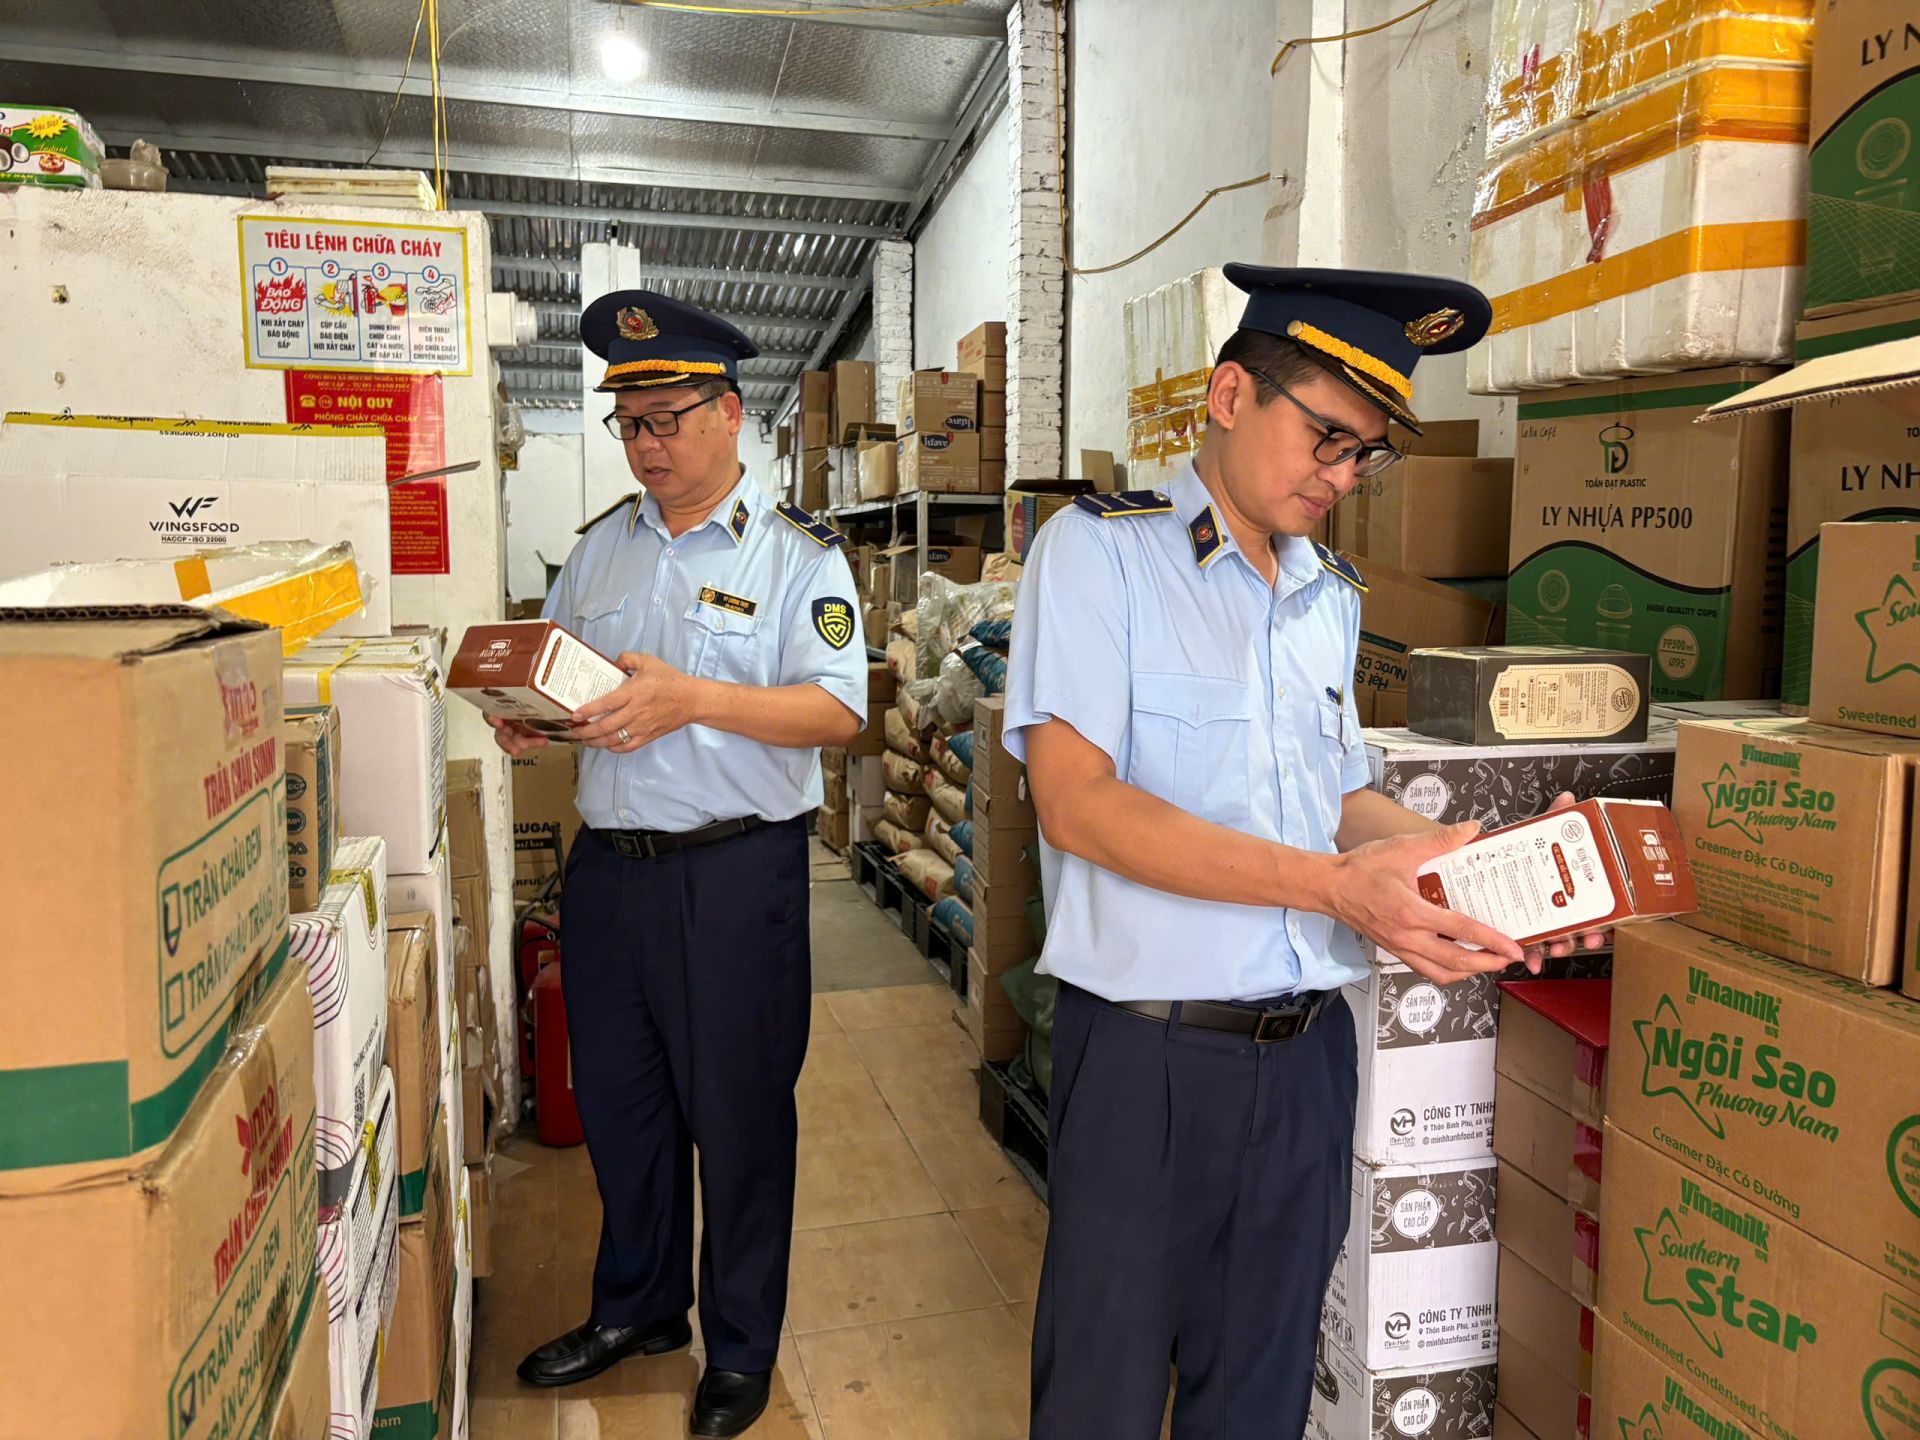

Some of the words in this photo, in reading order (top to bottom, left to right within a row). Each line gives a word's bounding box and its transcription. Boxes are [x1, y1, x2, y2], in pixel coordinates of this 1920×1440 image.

[1861, 29, 1892, 66] LY
[265, 229, 300, 249] TIÊU
[305, 233, 348, 256] LỆNH
[353, 233, 396, 255] CHỮA
[401, 238, 443, 258] CHÁY
[275, 261, 282, 271] 1
[327, 263, 335, 274] 2
[378, 266, 385, 277] 3
[427, 269, 435, 280] 4
[266, 285, 292, 298] BÁO
[261, 319, 272, 327] KHI
[288, 319, 304, 328] CHÁY
[338, 395, 362, 409] NỘI
[367, 397, 394, 409] QUY
[314, 412, 344, 421] PHÒNG
[346, 413, 369, 422] CHÁY
[1604, 479, 1618, 490] ĐẠT
[1620, 478, 1646, 488] PLASTIC
[1841, 464, 1871, 491] LY
[149, 521, 240, 534] WINGSFOOD
[1542, 506, 1562, 526] LY
[1567, 503, 1624, 533] NHỰA
[1631, 506, 1693, 529] PP500
[824, 603, 846, 614] DMS
[1647, 603, 1666, 613] HIGH
[1666, 605, 1696, 616] QUALITY
[1697, 608, 1718, 618] CUPS
[1838, 706, 1917, 729] Sweetened
[1742, 743, 1803, 770] Vinamilk
[204, 760, 232, 820] TRÂN
[1715, 780, 1777, 813] Ngôi
[1782, 781, 1836, 813] Sao
[1744, 810, 1799, 831] Phương
[1799, 812, 1837, 832] Nam
[1695, 836, 1743, 860] Creamer
[1744, 849, 1767, 868] Đặc
[1770, 856, 1786, 872] Có
[1789, 861, 1834, 888] Đường
[183, 860, 220, 928] TRÂN
[220, 835, 246, 897] CHÂU
[187, 942, 222, 1011] TRÂN
[1688, 966, 1782, 1027] Vinamilk
[1408, 1011, 1421, 1024] CAO
[1651, 1026, 1743, 1082] Ngôi
[1751, 1045, 1837, 1110] Sao
[1423, 1105, 1451, 1121] CÔNG
[1454, 1104, 1467, 1118] TY
[1470, 1102, 1495, 1116] TNHH
[1695, 1081, 1779, 1127] Phương
[1777, 1100, 1839, 1144] Nam
[1430, 1131, 1484, 1145] minhhanhfood.vn
[1652, 1126, 1705, 1162] Creamer
[1706, 1155, 1730, 1178] Đặc
[1733, 1170, 1751, 1188] Có
[1753, 1179, 1801, 1219] Đường
[1403, 1216, 1416, 1229] CAO
[1680, 1176, 1771, 1253] Vinamilk
[1659, 1234, 1741, 1274] Southern
[198, 1323, 234, 1408] TRÂN
[235, 1257, 262, 1340] CHÂU
[263, 1217, 280, 1281] ĐEN
[1418, 1309, 1446, 1325] CÔNG
[1450, 1308, 1462, 1321] TY
[1465, 1303, 1492, 1318] TNHH
[1684, 1267, 1817, 1353] Star
[1426, 1333, 1479, 1347] minhhanhfood.vn
[1621, 1312, 1684, 1366] Sweetened
[1686, 1358, 1757, 1418] Condensed
[1403, 1414, 1414, 1427] CAO
